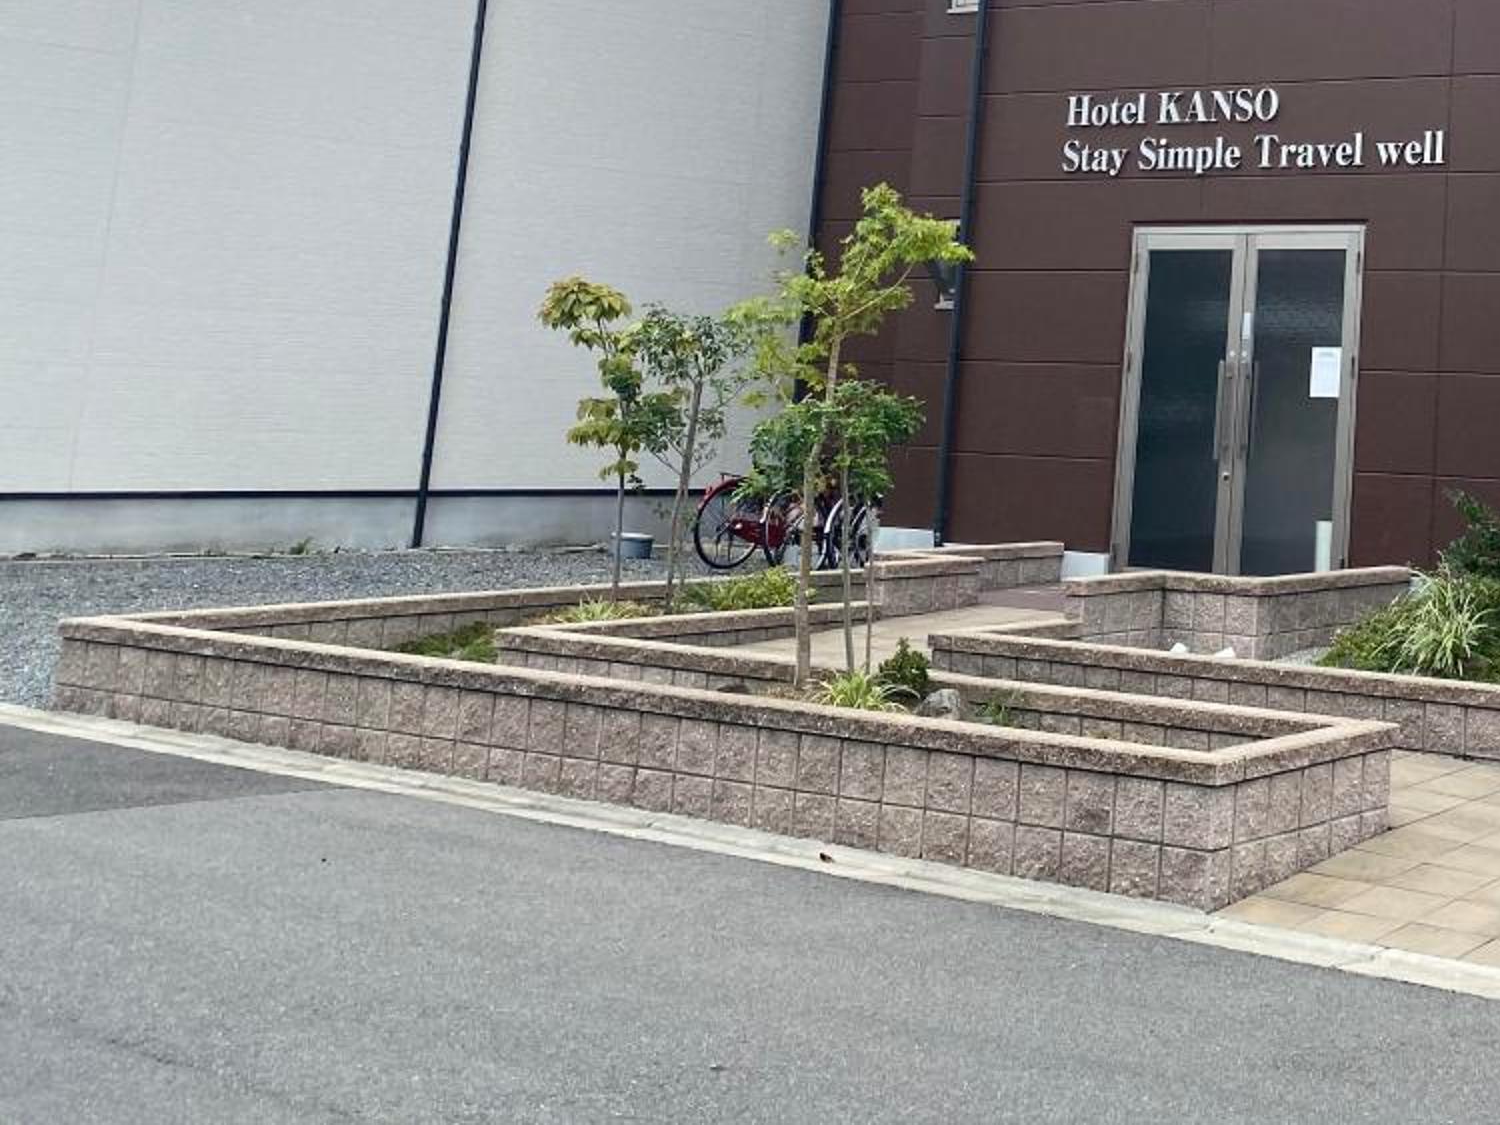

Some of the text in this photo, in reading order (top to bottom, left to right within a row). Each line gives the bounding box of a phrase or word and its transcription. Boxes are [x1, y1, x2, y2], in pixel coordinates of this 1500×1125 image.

[1066, 88, 1280, 126] Hotel KANSO
[1062, 129, 1445, 176] Stay Simple Travel well
